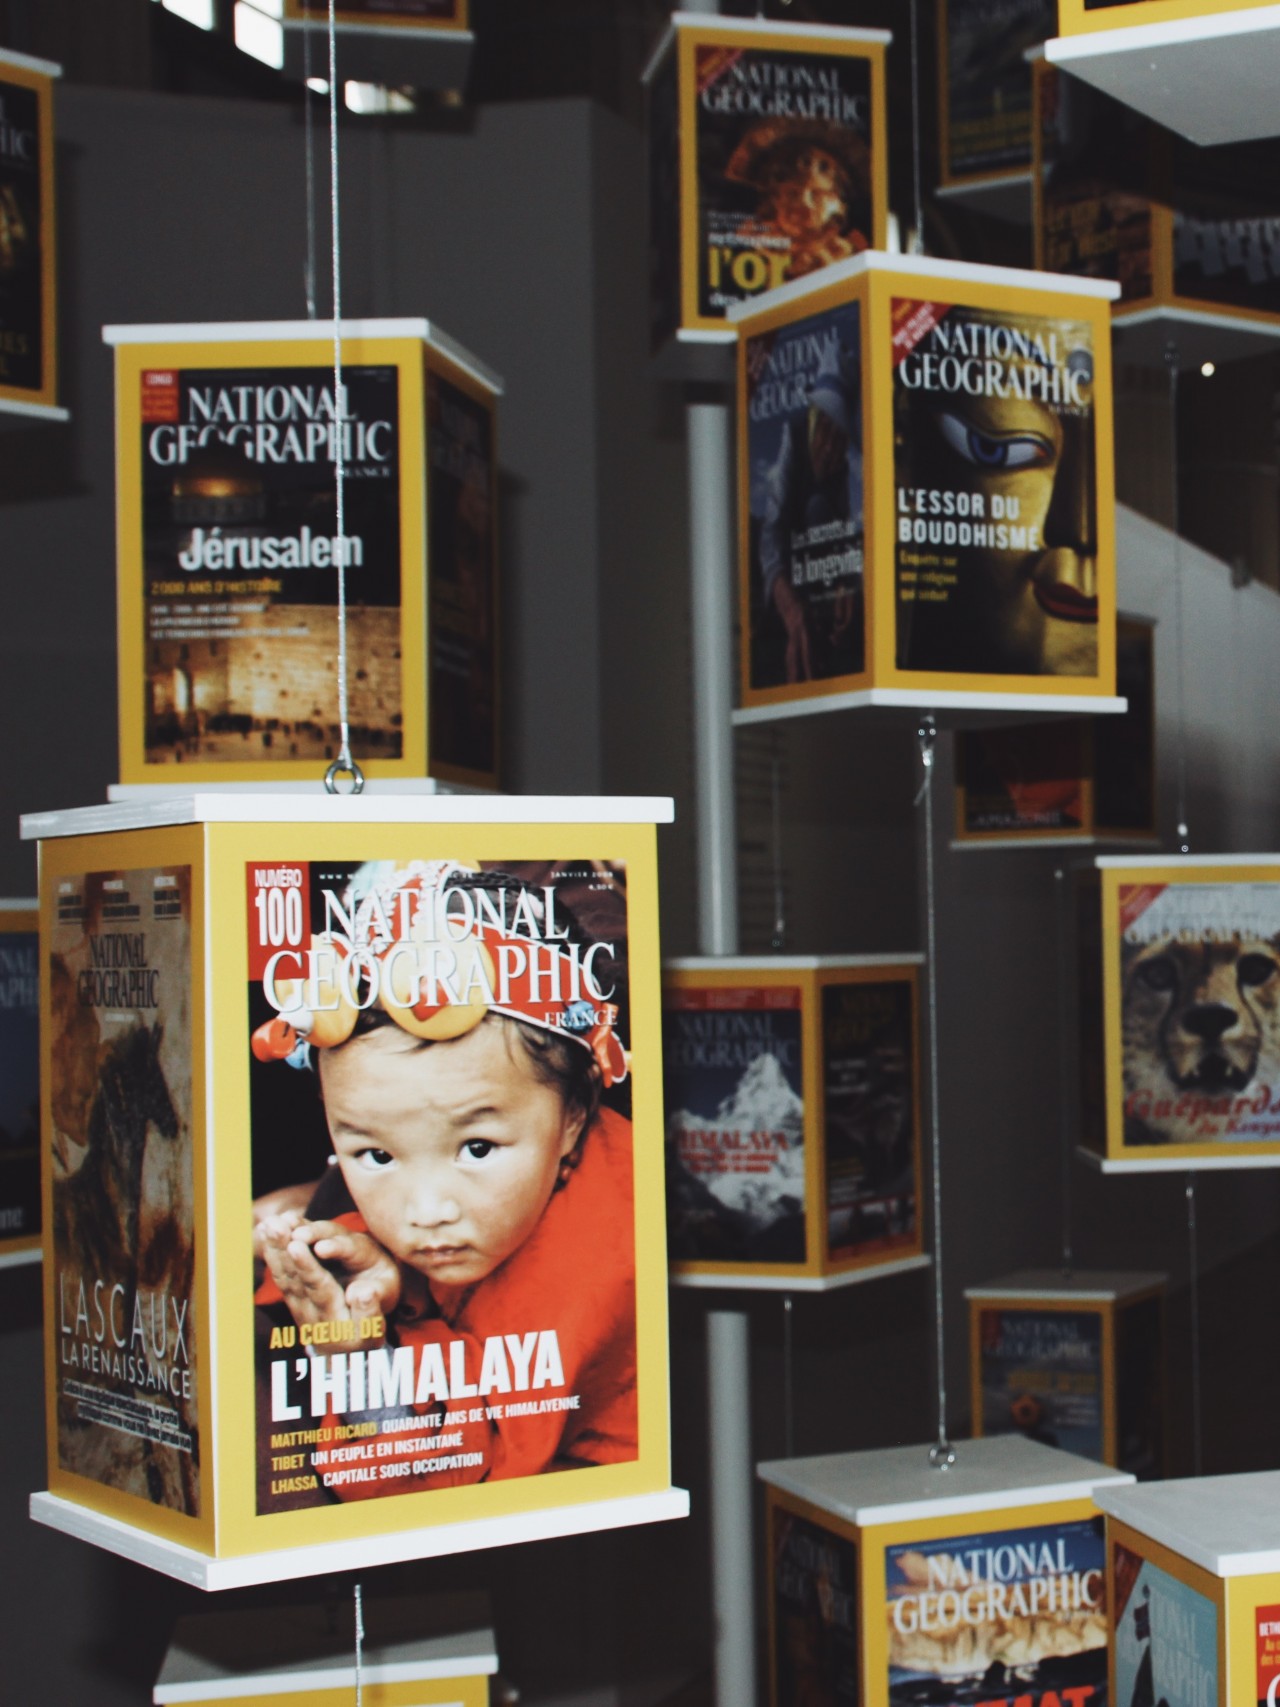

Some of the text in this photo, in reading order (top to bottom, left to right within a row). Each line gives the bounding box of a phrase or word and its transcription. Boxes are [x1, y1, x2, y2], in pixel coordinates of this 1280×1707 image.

[731, 60, 842, 92] NATIONAL
[702, 87, 863, 124] GEOGRAPHIC
[912, 320, 1066, 370] NATIONAL
[899, 352, 1092, 406] GEOGRAPHIC
[188, 383, 358, 424] NATIONAL
[898, 487, 1021, 521] L'ESSOR DU
[178, 525, 363, 572] Jérusalem
[899, 517, 1041, 551] BOUDDHISME
[255, 865, 303, 888] NUMÉRO
[551, 871, 589, 879] JANVIER
[255, 887, 303, 947] 100
[321, 885, 570, 946] NATIONAL
[90, 933, 148, 968] NATIONAL
[77, 969, 160, 1009] GEOGRAPHIC
[262, 942, 616, 1014] GEOGRAPHIC
[544, 1005, 619, 1029] FRANCE
[60, 1272, 189, 1364] LASCAUX
[269, 1315, 384, 1350] AU CŒUR DE
[61, 1338, 192, 1400] LA RENAISSANCE
[271, 1329, 566, 1423] L'HIMALAYA
[271, 1395, 581, 1449] MATTHIEU RICARD QUARANTE ANS DE VIE HIMALAYENNE
[272, 1430, 464, 1472] TIBET UN PEUPLE EN INSTANTANÉ
[271, 1452, 483, 1495] LHASSA CAPITALE SOUS OCCUPATION
[927, 1538, 1074, 1590] NATIONAL
[893, 1569, 1103, 1635] GEOGRAPHIC
